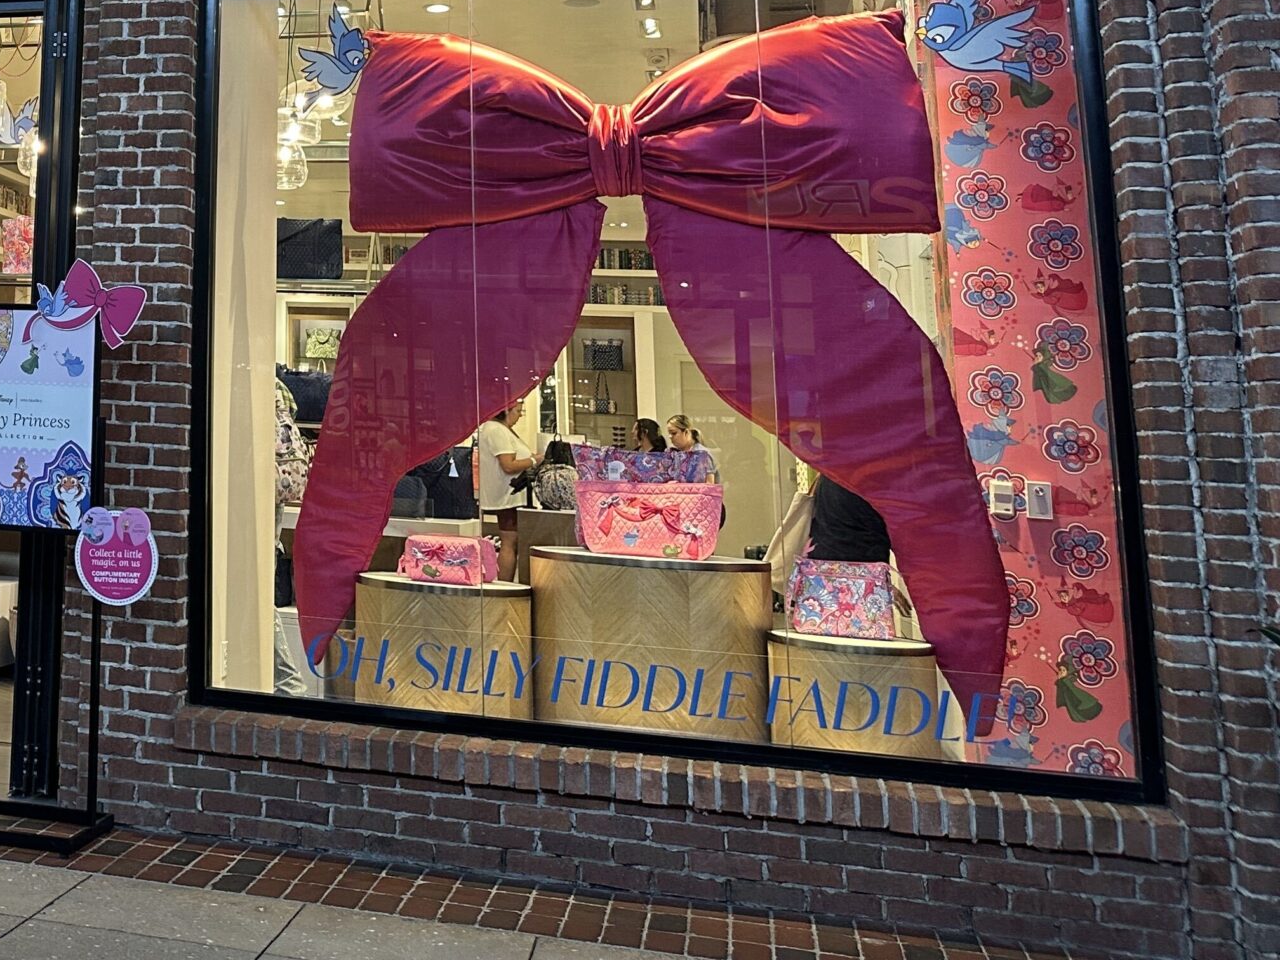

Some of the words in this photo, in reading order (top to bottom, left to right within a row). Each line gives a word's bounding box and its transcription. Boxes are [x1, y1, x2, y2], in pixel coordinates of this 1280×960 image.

[13, 412, 71, 429] Princess
[89, 548, 115, 558] Collect
[124, 549, 143, 559] little
[91, 558, 117, 569] magic,
[131, 560, 141, 568] us
[91, 570, 141, 578] COMPLIMENTARY
[307, 632, 396, 694] OH,
[410, 642, 542, 700] SILLY
[550, 656, 753, 722] FIDDLE
